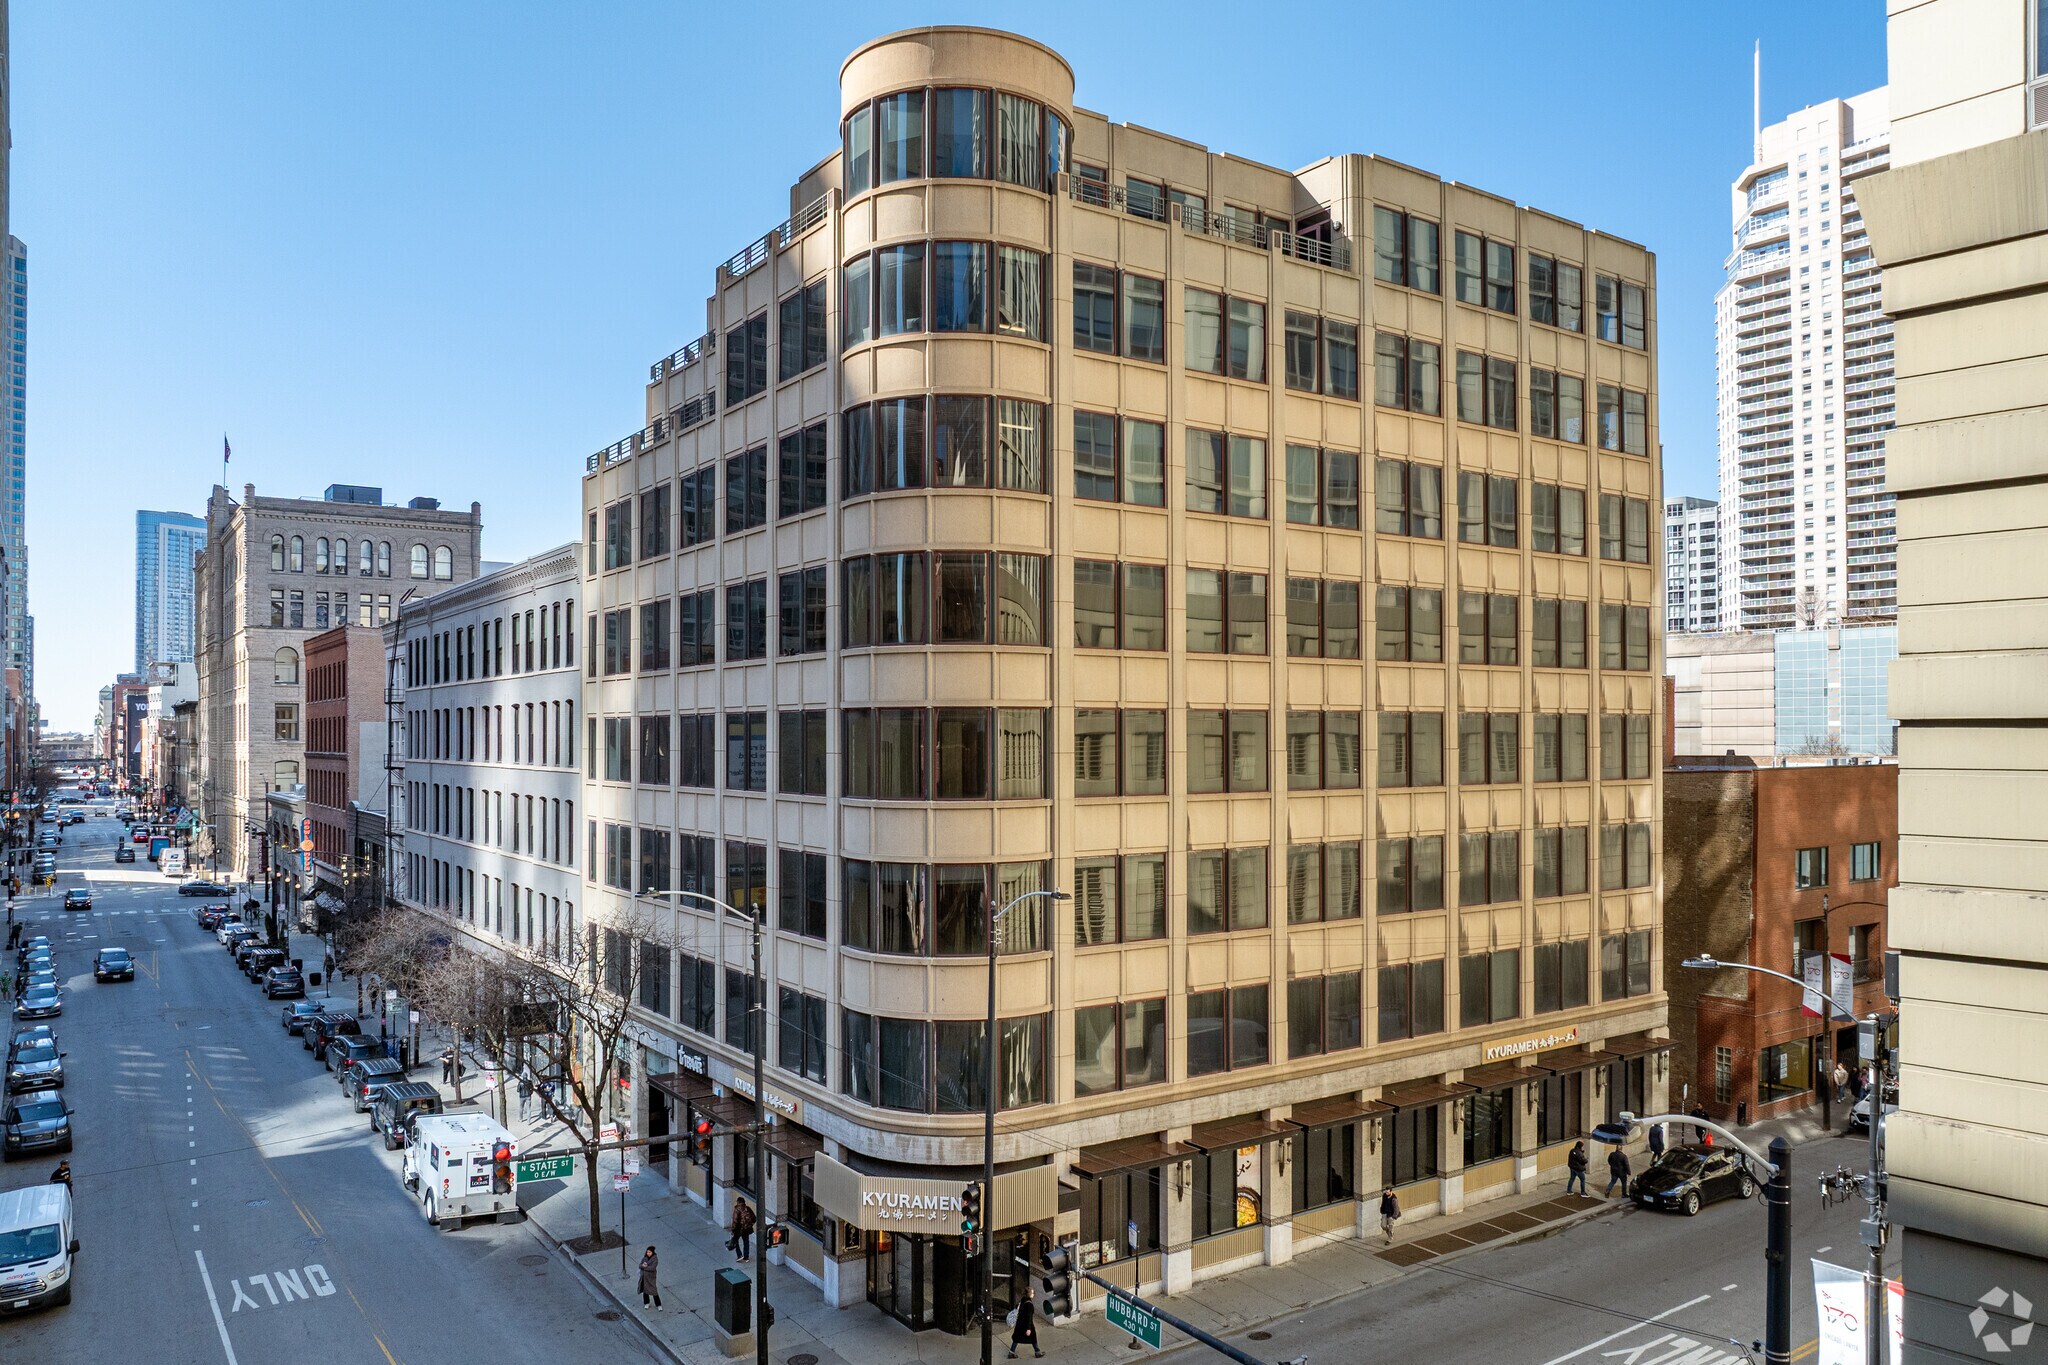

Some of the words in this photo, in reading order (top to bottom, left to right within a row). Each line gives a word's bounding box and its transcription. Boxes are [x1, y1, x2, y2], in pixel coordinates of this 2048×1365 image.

[1487, 1039, 1538, 1059] KYURAMEN
[529, 1160, 558, 1172] STATE
[863, 1191, 962, 1212] KYURAMEN
[231, 1264, 337, 1313] ONLY
[1109, 1296, 1148, 1328] HUBBARD
[1150, 1321, 1158, 1332] ST
[1123, 1319, 1136, 1332] 430
[1138, 1326, 1144, 1336] N
